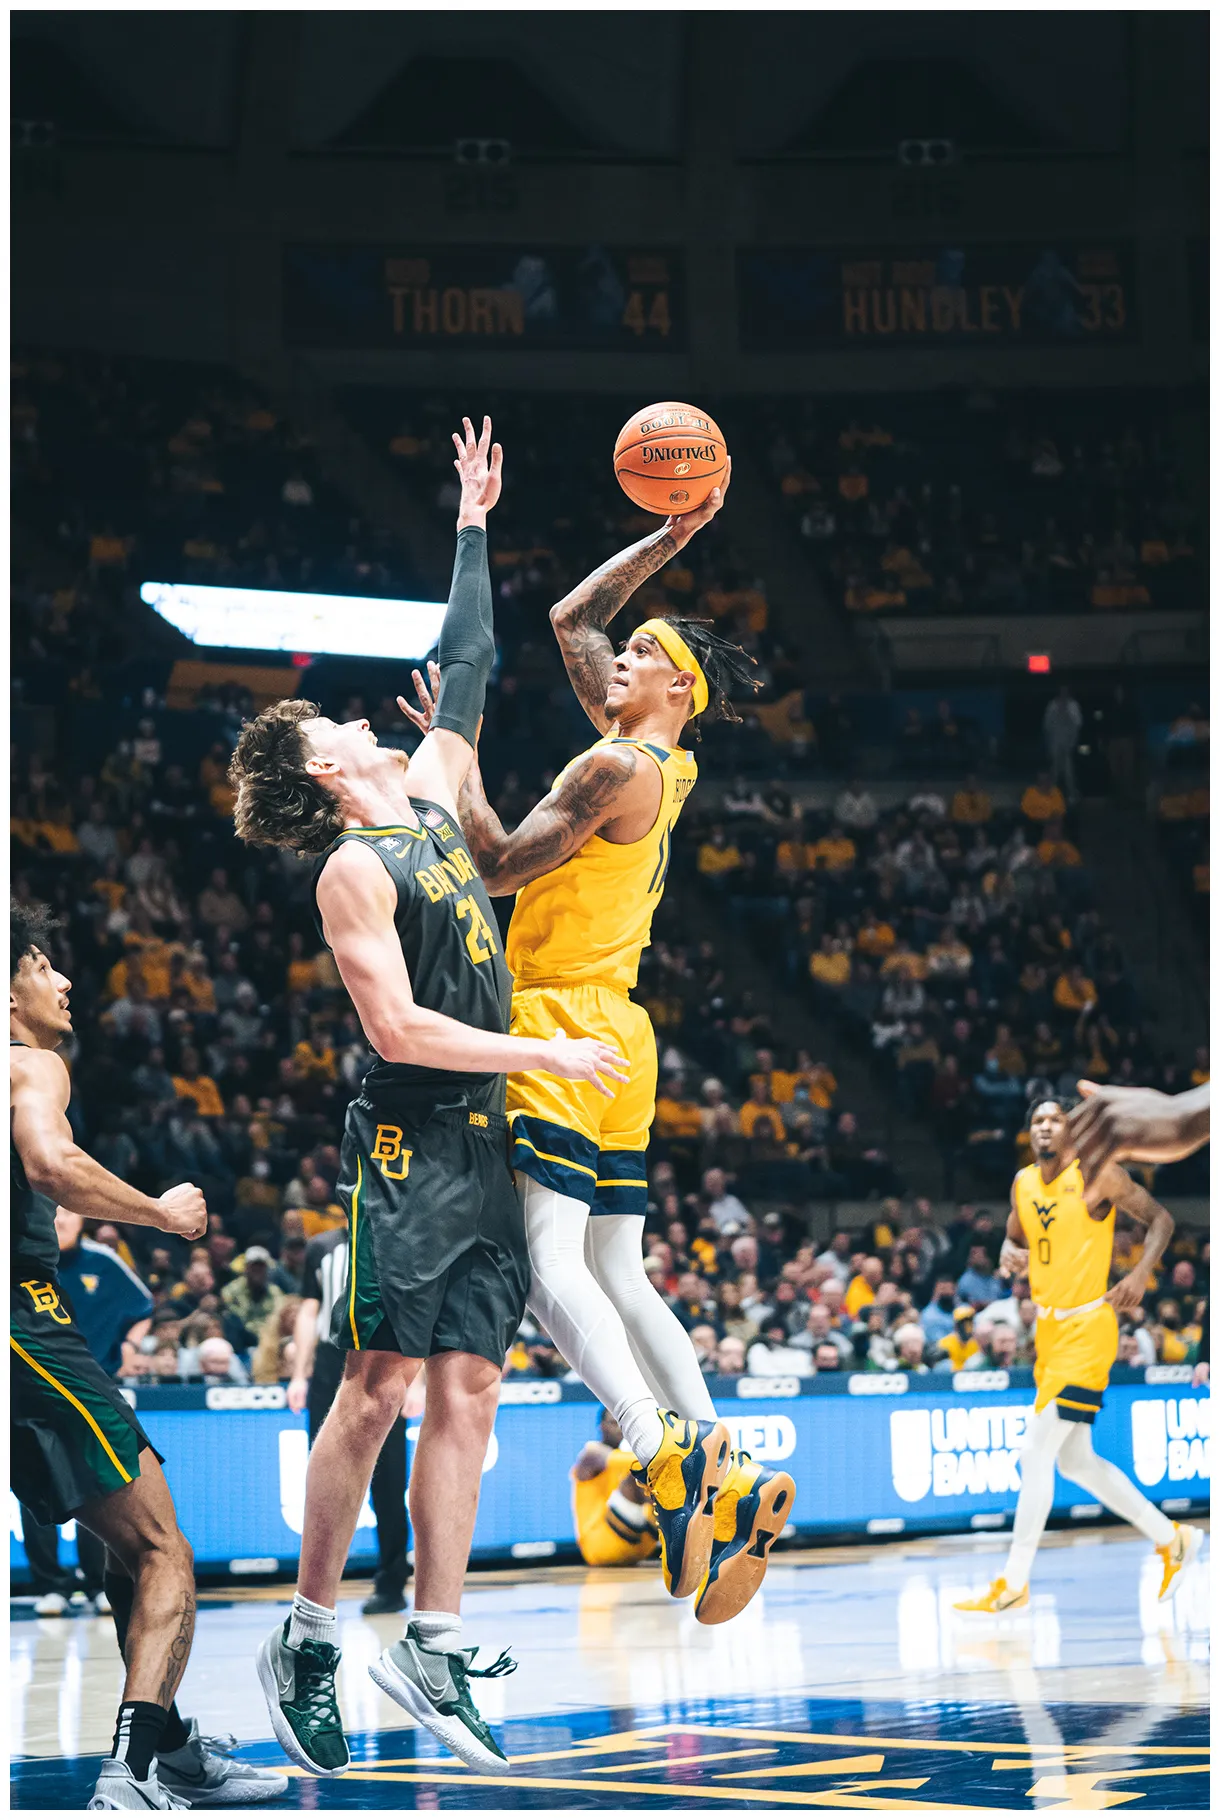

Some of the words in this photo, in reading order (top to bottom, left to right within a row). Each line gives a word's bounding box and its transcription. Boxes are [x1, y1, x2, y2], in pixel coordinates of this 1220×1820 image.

[387, 285, 525, 337] THORN
[622, 289, 672, 339] 44
[842, 284, 1027, 335] HUNDLEY
[1079, 284, 1126, 331] 33
[642, 444, 717, 464] SPALDING
[456, 894, 498, 965] 24
[469, 1111, 489, 1129] BEARS
[370, 1123, 413, 1181] BU
[1038, 1238, 1051, 1265] 0
[719, 1414, 797, 1462] TED
[931, 1406, 1034, 1453] UNITE
[1166, 1398, 1210, 1440] UN
[933, 1450, 1022, 1497] BANK
